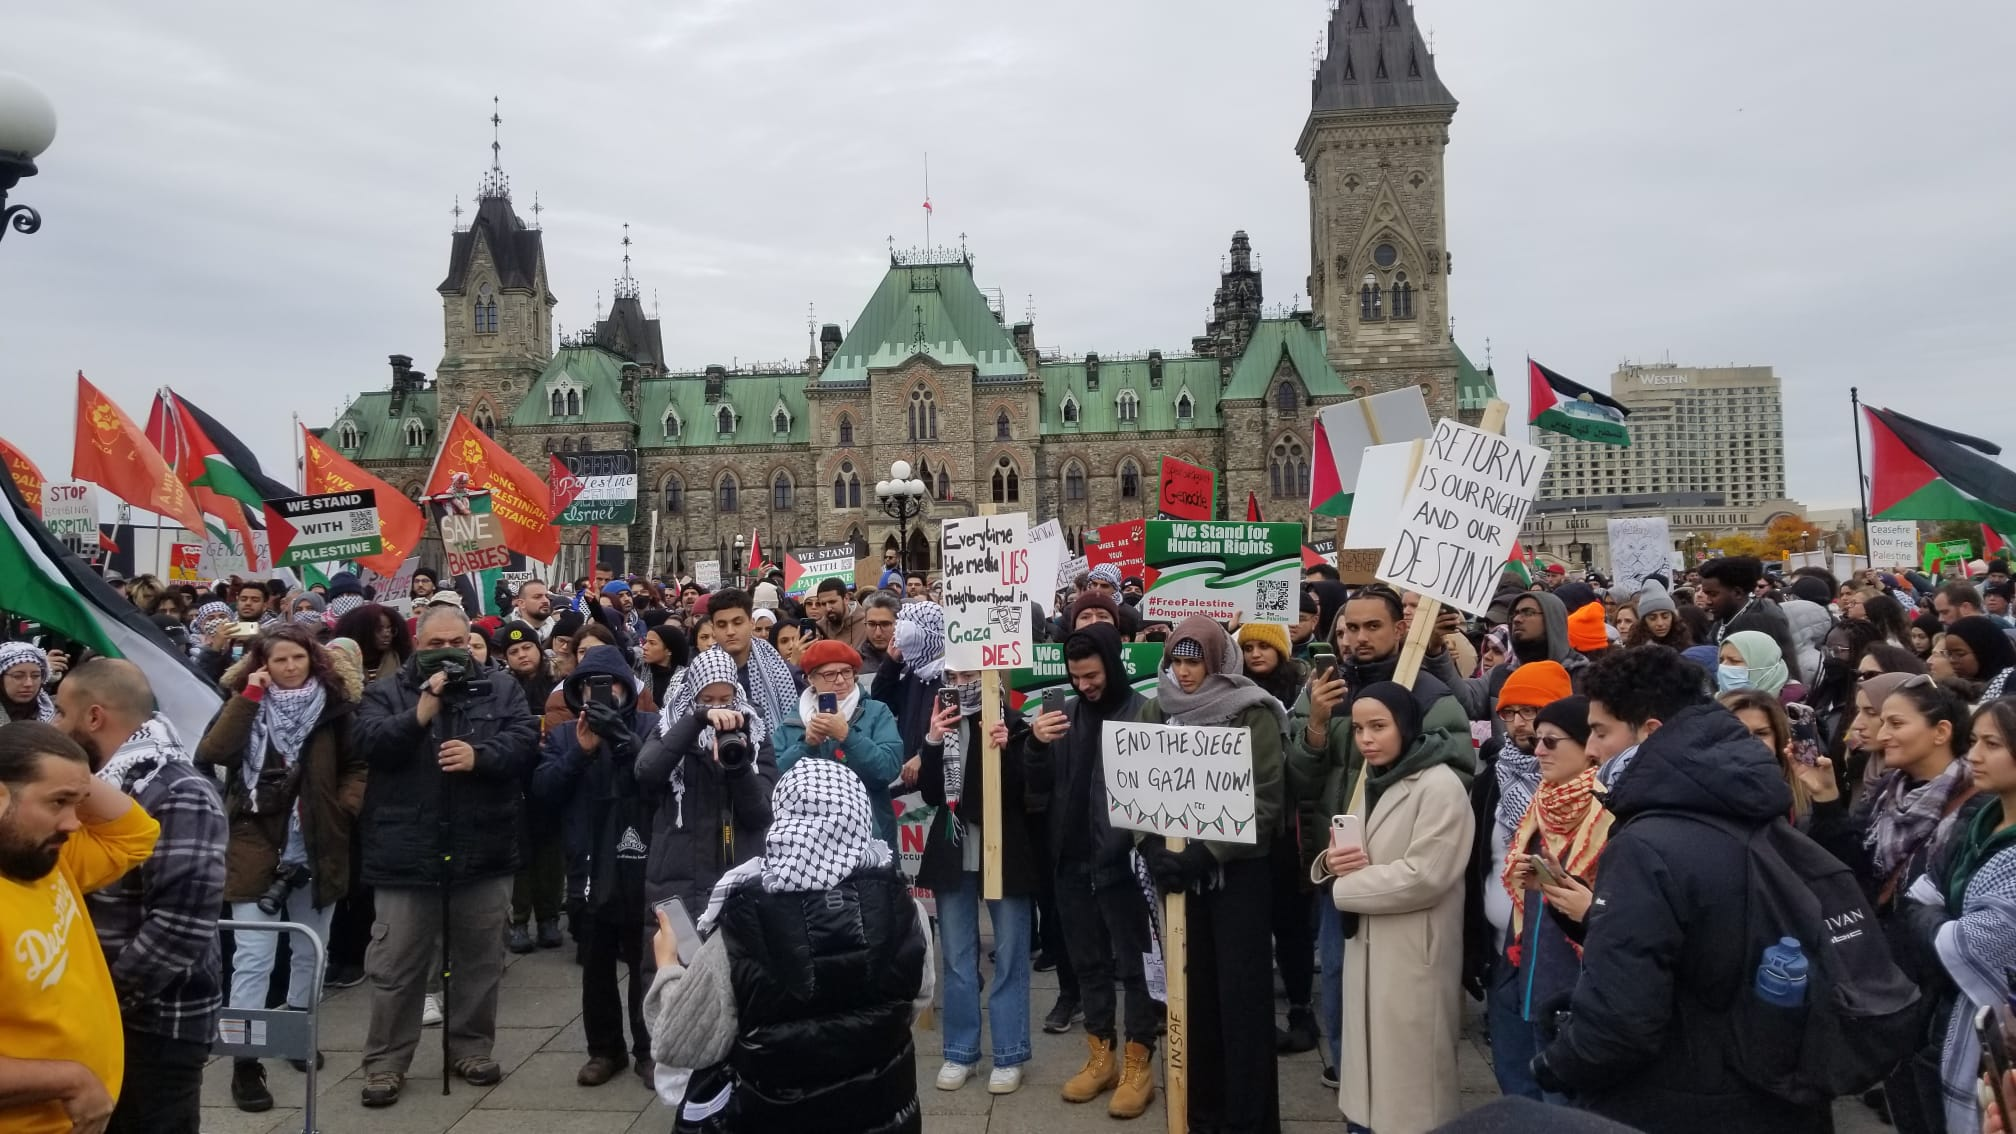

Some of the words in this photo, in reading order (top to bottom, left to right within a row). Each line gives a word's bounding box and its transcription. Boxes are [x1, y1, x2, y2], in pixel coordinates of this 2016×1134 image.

[1639, 374, 1688, 385] WESTIN
[1429, 422, 1537, 487] RETURN
[567, 454, 632, 476] DEFEND
[50, 485, 87, 502] STOP
[1419, 465, 1439, 492] IS
[1441, 474, 1480, 507] OUR
[1480, 486, 1531, 525] RIGHT
[286, 499, 311, 513] WE
[312, 494, 363, 510] STAND
[490, 500, 538, 530] SISTANCE
[563, 506, 619, 522] Israel
[302, 520, 344, 536] WITH
[441, 513, 493, 543] SAVE
[1171, 523, 1197, 539] We
[1200, 524, 1245, 540] Stand
[1247, 525, 1270, 540] for
[1412, 501, 1459, 530] AND
[1467, 519, 1501, 547] OUR
[1871, 525, 1911, 535] Ceasefire
[943, 518, 1013, 551] Everytime
[1118, 538, 1129, 547] ARE
[1873, 538, 1893, 546] Now
[1896, 539, 1914, 548] Free
[291, 541, 372, 562] PALESTINE
[453, 540, 479, 552] THE
[798, 552, 815, 561] WE
[818, 547, 853, 559] STAND
[1167, 538, 1221, 554] Human
[1224, 540, 1273, 556] Rights
[1314, 541, 1334, 552] WE
[447, 544, 511, 577] BABIES
[1873, 551, 1912, 561] Palestine
[809, 562, 837, 573] WITH
[944, 554, 965, 577] the
[966, 547, 1000, 574] media
[1001, 548, 1029, 586] LIES
[1387, 528, 1510, 608] DESTINY
[1019, 590, 1029, 602] in
[1148, 596, 1235, 608] #FreePalestine
[947, 620, 992, 644] Gaza
[982, 640, 1022, 667] DIES
[1037, 646, 1061, 661] We
[1033, 663, 1068, 676] Hum
[1115, 728, 1151, 756] END
[1156, 730, 1189, 755] THE
[1192, 730, 1246, 757] SIEGE
[1116, 768, 1139, 789] ON
[1148, 767, 1196, 792] GAZA
[1205, 768, 1251, 797] NOW!
[1169, 1011, 1183, 1070] INSAF
